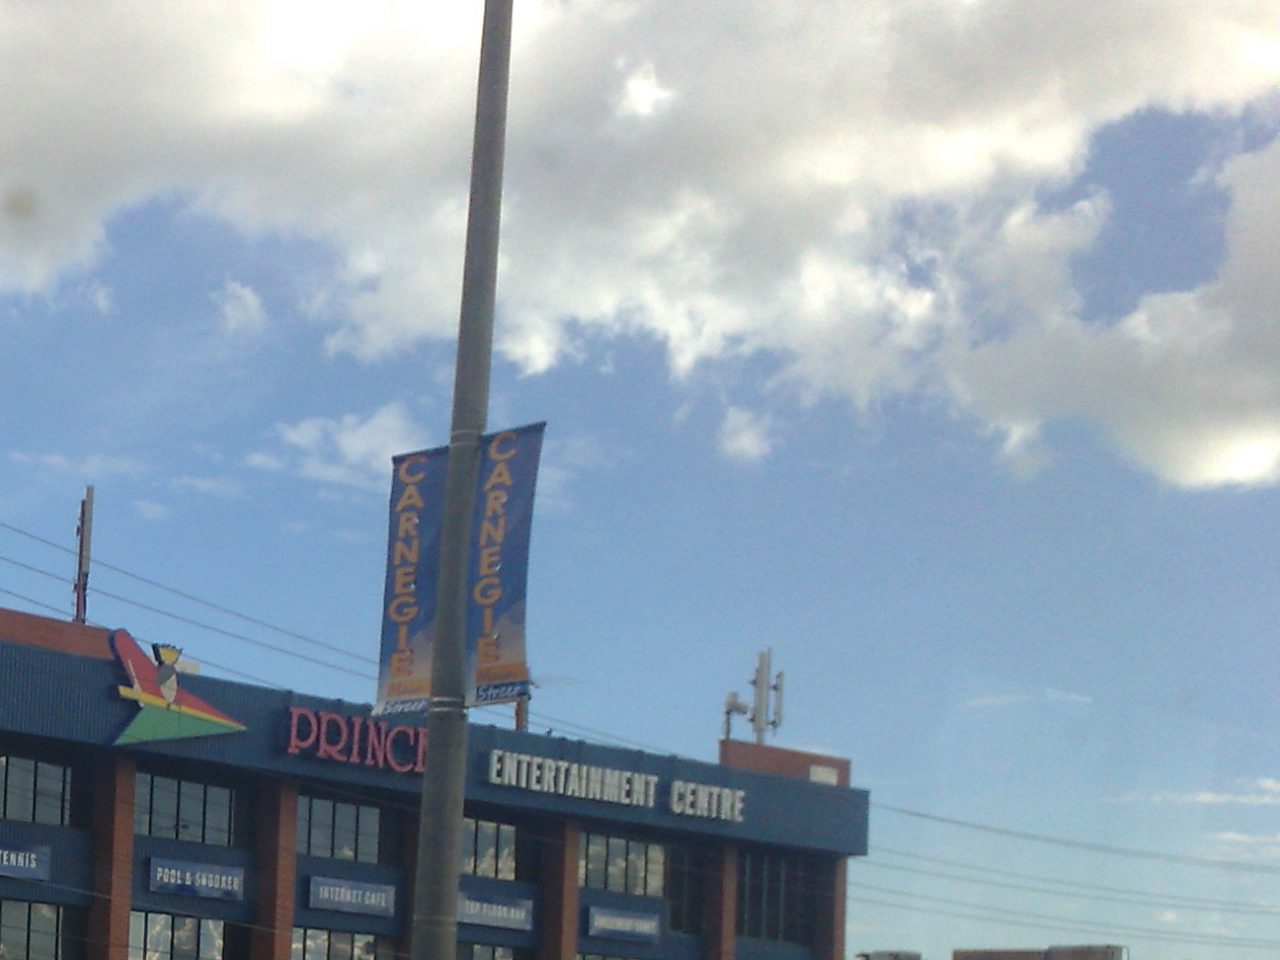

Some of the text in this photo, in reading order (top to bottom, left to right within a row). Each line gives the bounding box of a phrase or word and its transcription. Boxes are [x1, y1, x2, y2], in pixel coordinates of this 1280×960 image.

[389, 455, 427, 678] CARNEGIE
[473, 432, 517, 663] CARNEGIE
[488, 749, 658, 808] ENTERTAINMENT
[671, 780, 745, 822] CENTRE
[156, 867, 182, 885] POOL
[195, 871, 240, 890] SNOOKER
